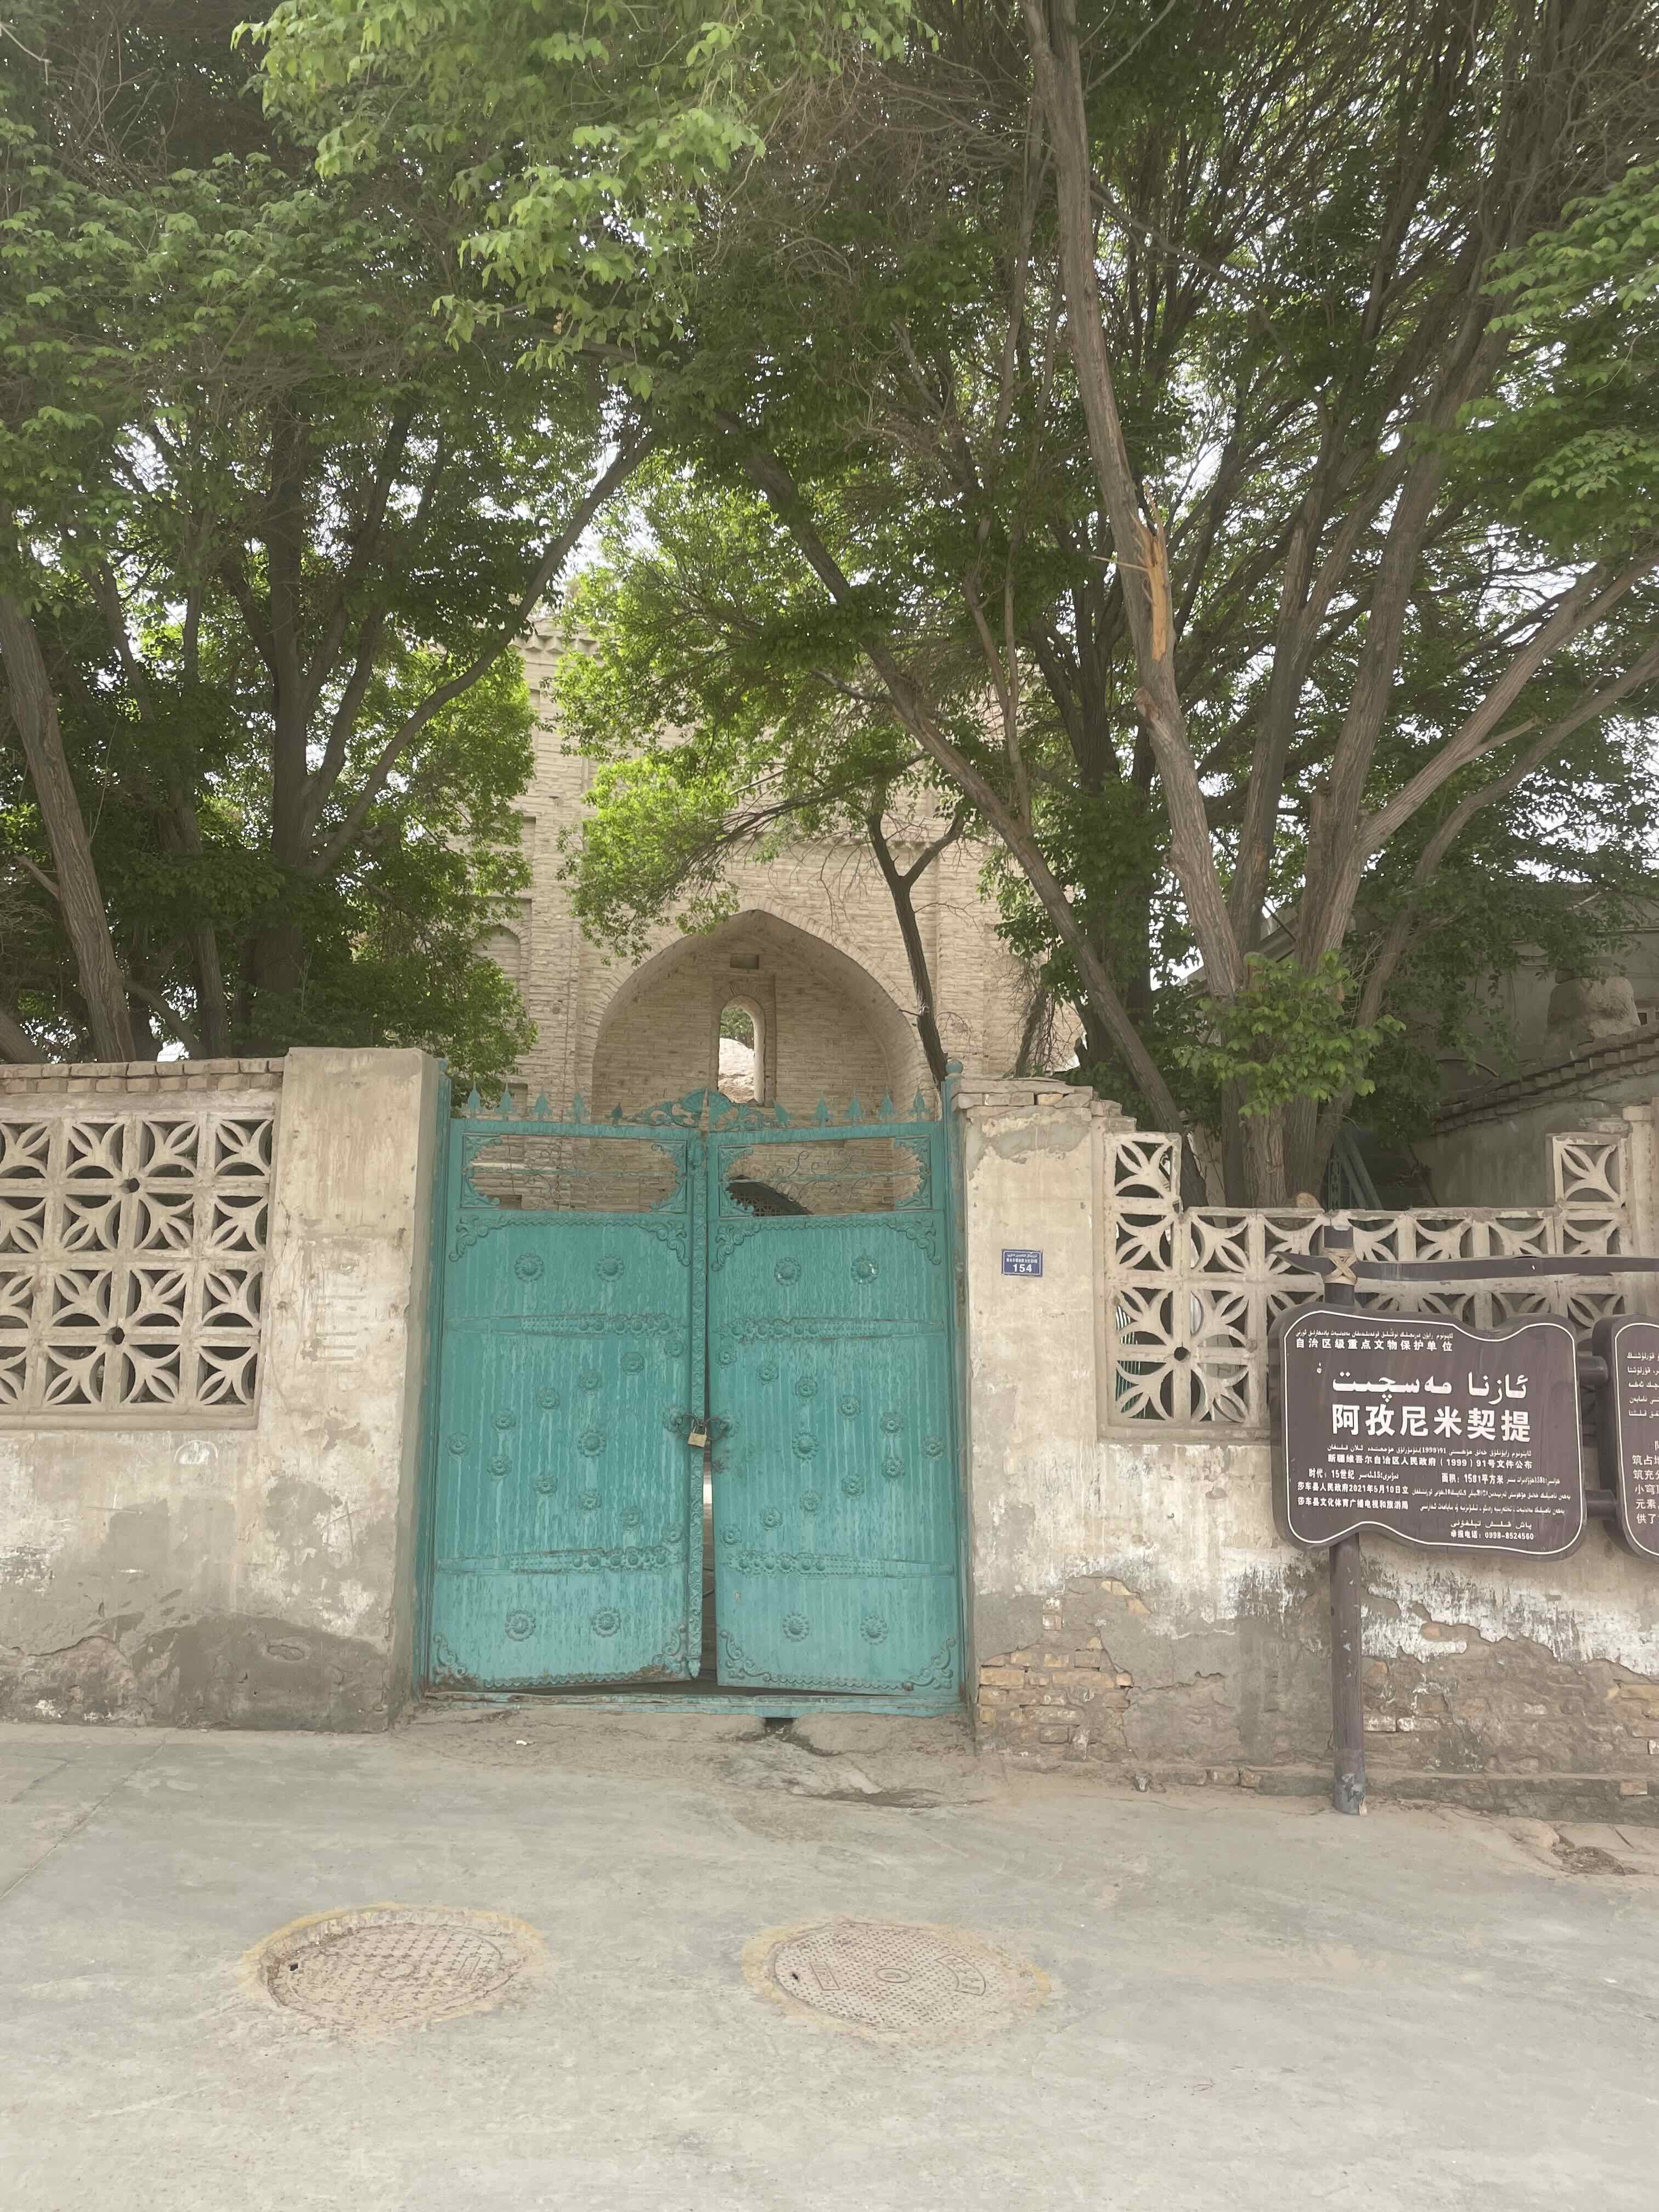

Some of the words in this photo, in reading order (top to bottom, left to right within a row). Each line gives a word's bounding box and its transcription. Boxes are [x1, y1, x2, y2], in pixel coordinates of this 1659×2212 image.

[1013, 1263, 1032, 1272] 154
[1296, 1338, 1453, 1352] 自治区级重点文物保护单位
[1331, 1403, 1531, 1443] 阿孜尼米契提
[1297, 1481, 1409, 1495] 莎车县人民政府2021年5月10日立
[1635, 1484, 1659, 1495] 小穹
[1297, 1496, 1409, 1510] 莎车县文化体育广播电视和旅游局
[1635, 1499, 1659, 1509] 元素
[1636, 1513, 1659, 1525] 供了
